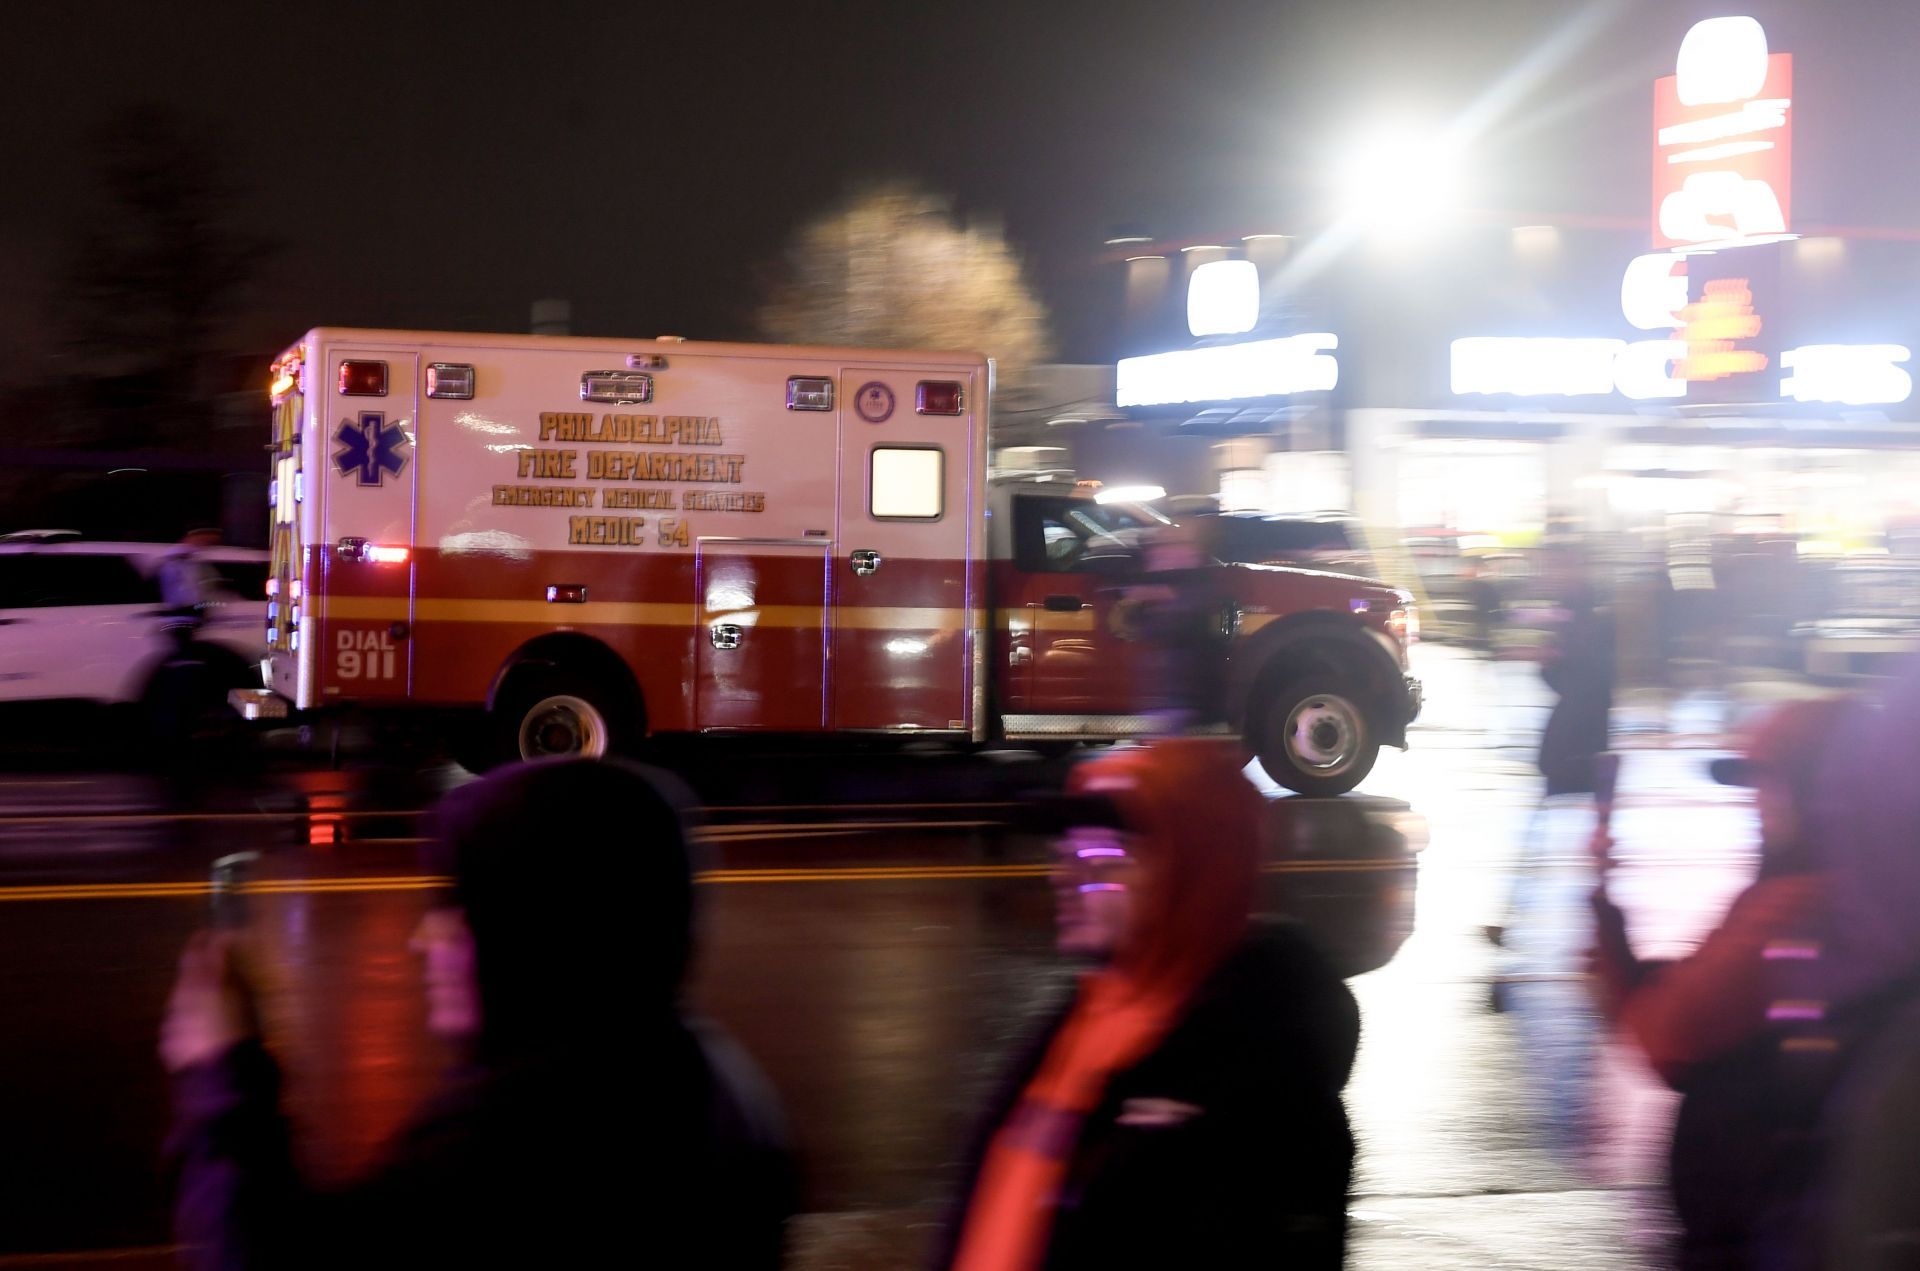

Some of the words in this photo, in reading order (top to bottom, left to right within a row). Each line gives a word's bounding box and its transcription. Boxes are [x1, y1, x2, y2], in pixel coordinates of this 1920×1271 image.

[539, 412, 722, 445] PHILADELPHIA
[517, 449, 577, 478] FIRE
[587, 451, 745, 483] DEPARTMENT
[492, 485, 596, 508] EMERGENCY
[602, 487, 677, 510] MEDICAL
[682, 490, 765, 512] SERVICES
[568, 515, 644, 545] MEDIC
[657, 519, 689, 547] 54
[336, 629, 396, 650] DIAL
[336, 650, 396, 679] 911
